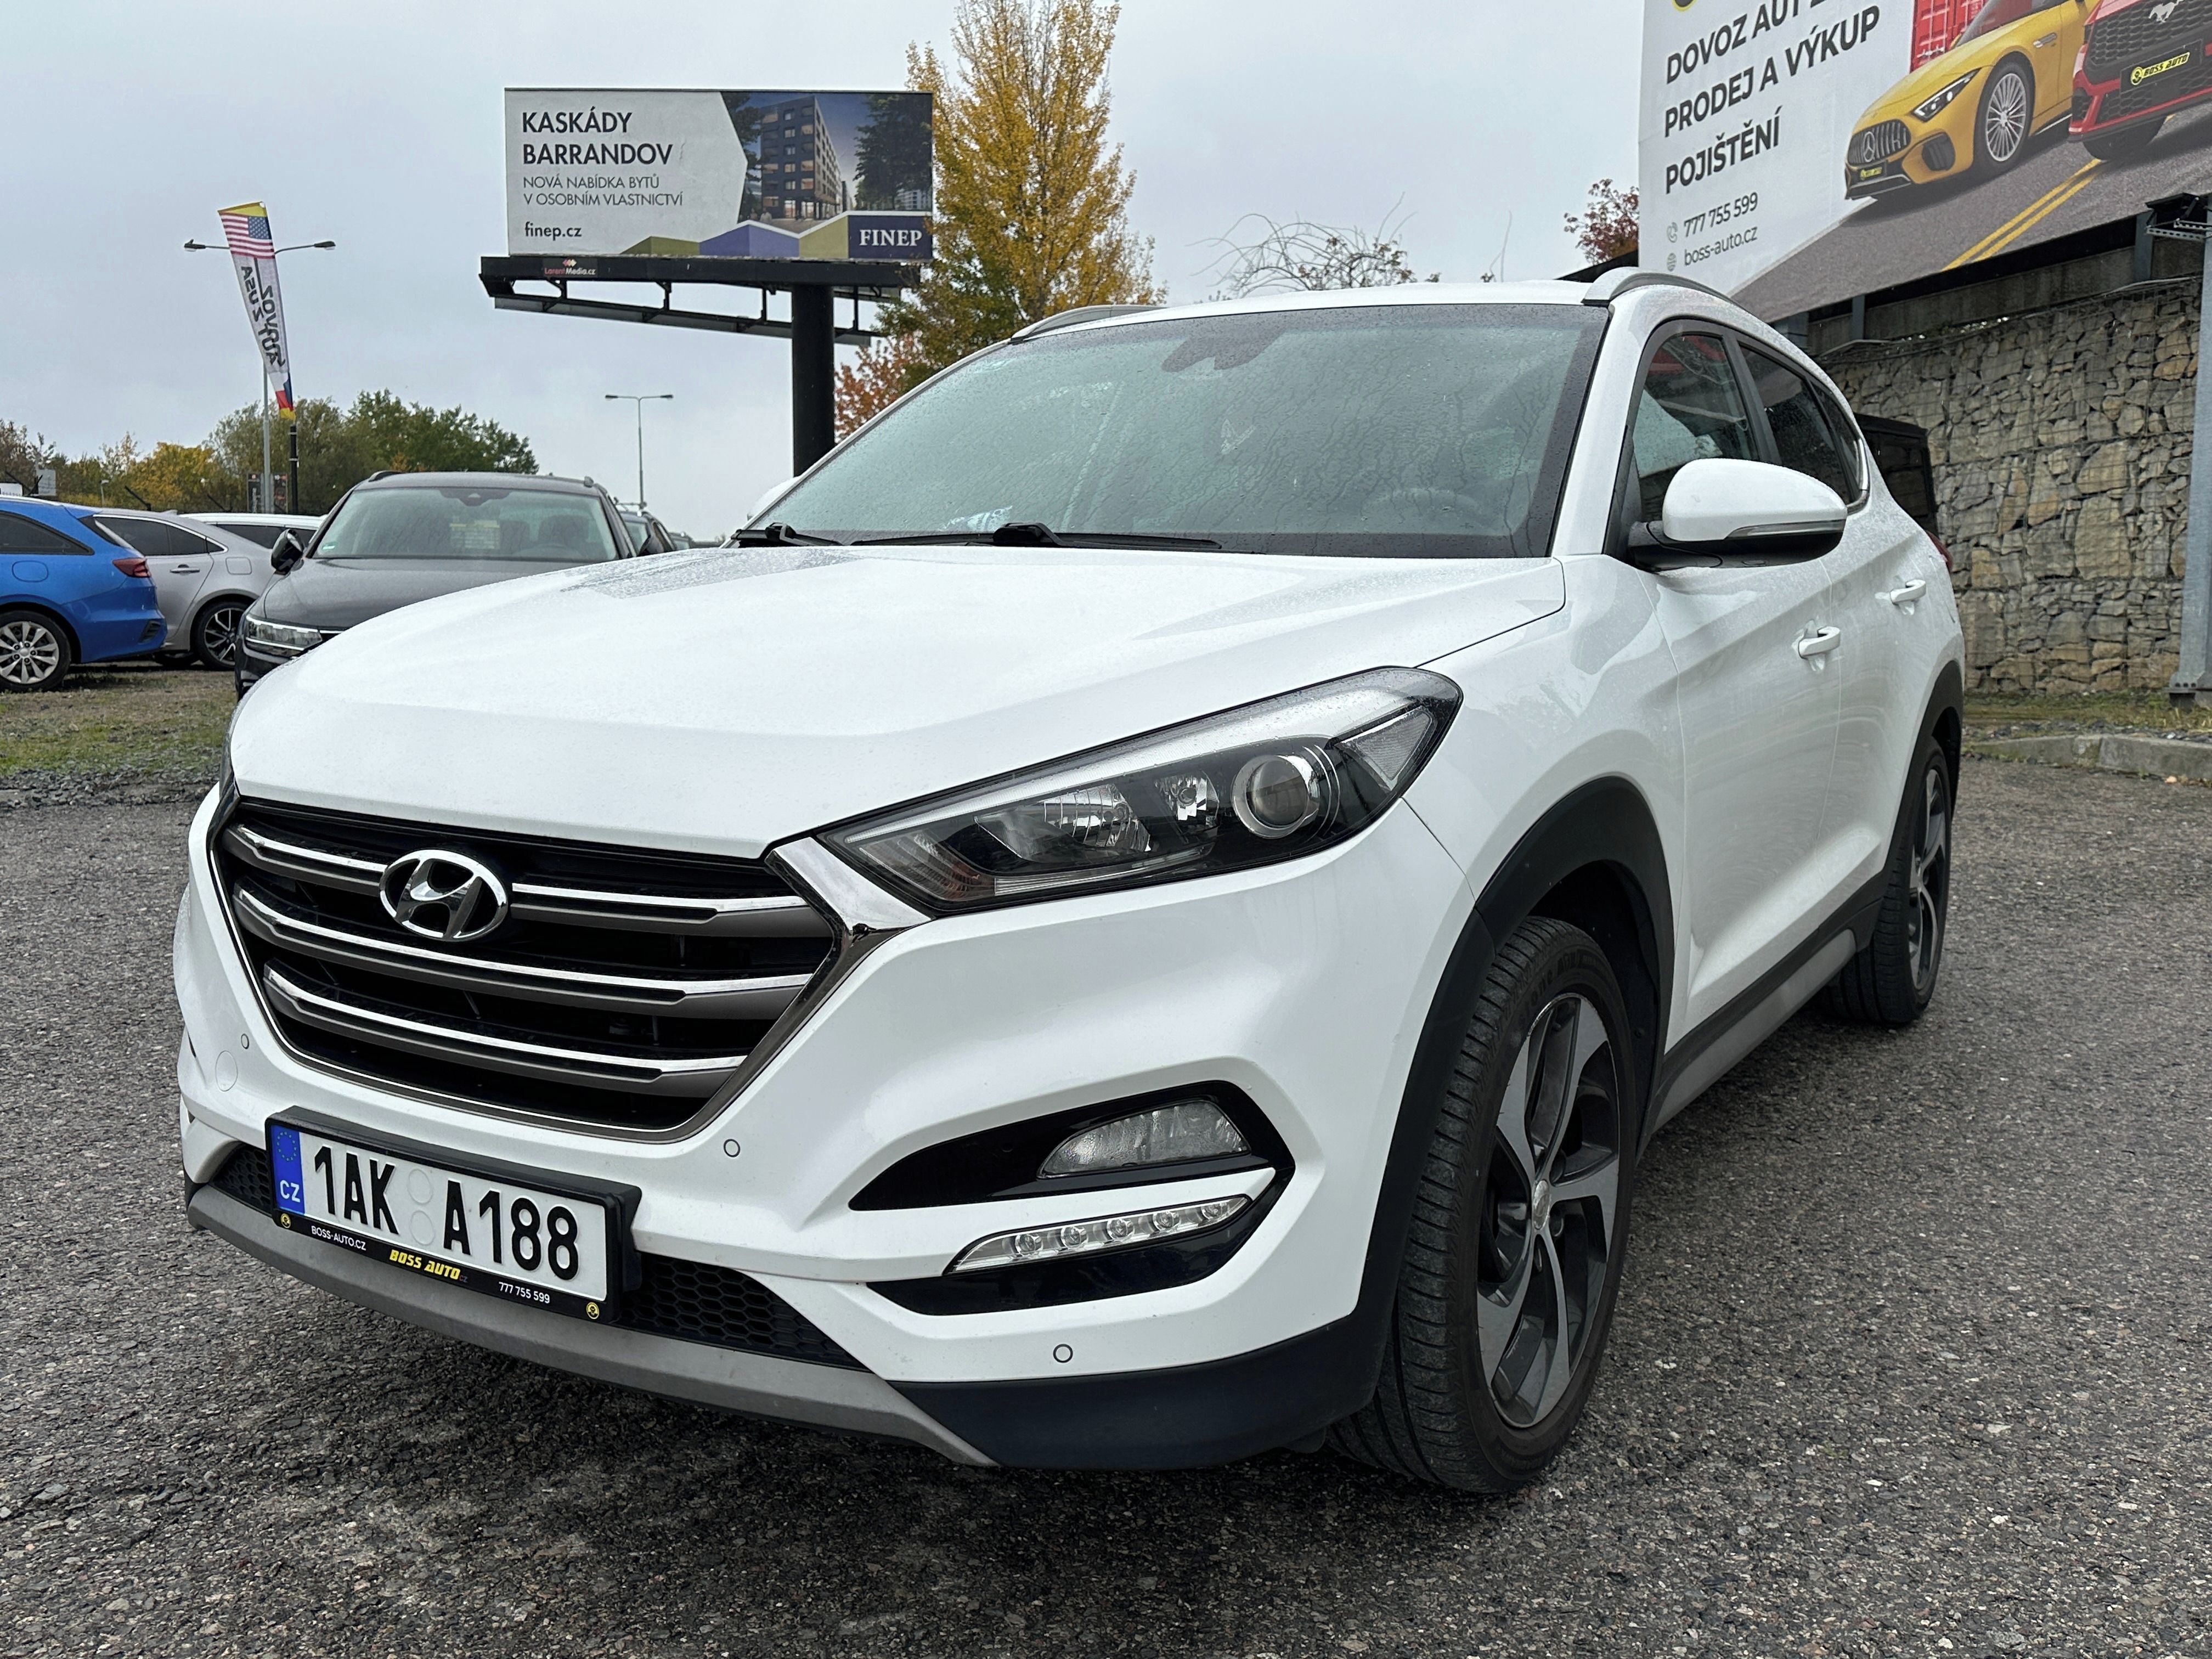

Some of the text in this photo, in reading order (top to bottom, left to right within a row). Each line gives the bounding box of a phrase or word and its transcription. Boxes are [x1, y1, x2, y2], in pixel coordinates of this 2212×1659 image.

[1667, 14, 1747, 84] DOVOZ
[1665, 5, 1880, 137] PRODEJ A VÝKUP
[522, 106, 632, 133] KASKÁDY
[523, 144, 673, 165] BARRANDOV
[1666, 106, 1782, 194] POJIŠTĚNÍ
[523, 173, 659, 189] NOVÁ NABÍDKA BYTŮ
[524, 190, 684, 207] V OSOBNÍM VLASTNICTVÍ
[1684, 192, 1758, 238] 777 755 599
[524, 222, 582, 241] finep.cz
[859, 229, 922, 246] FINEP
[1684, 227, 1758, 266] boss-auto.cz
[280, 1180, 301, 1203] CZ
[314, 1146, 579, 1281] 1AK A188
[311, 1226, 366, 1251] BOSS-AUTO.CZ
[390, 1249, 422, 1269] BOSS
[424, 1260, 461, 1280] AUTO
[499, 1281, 550, 1304] 777 755 599
